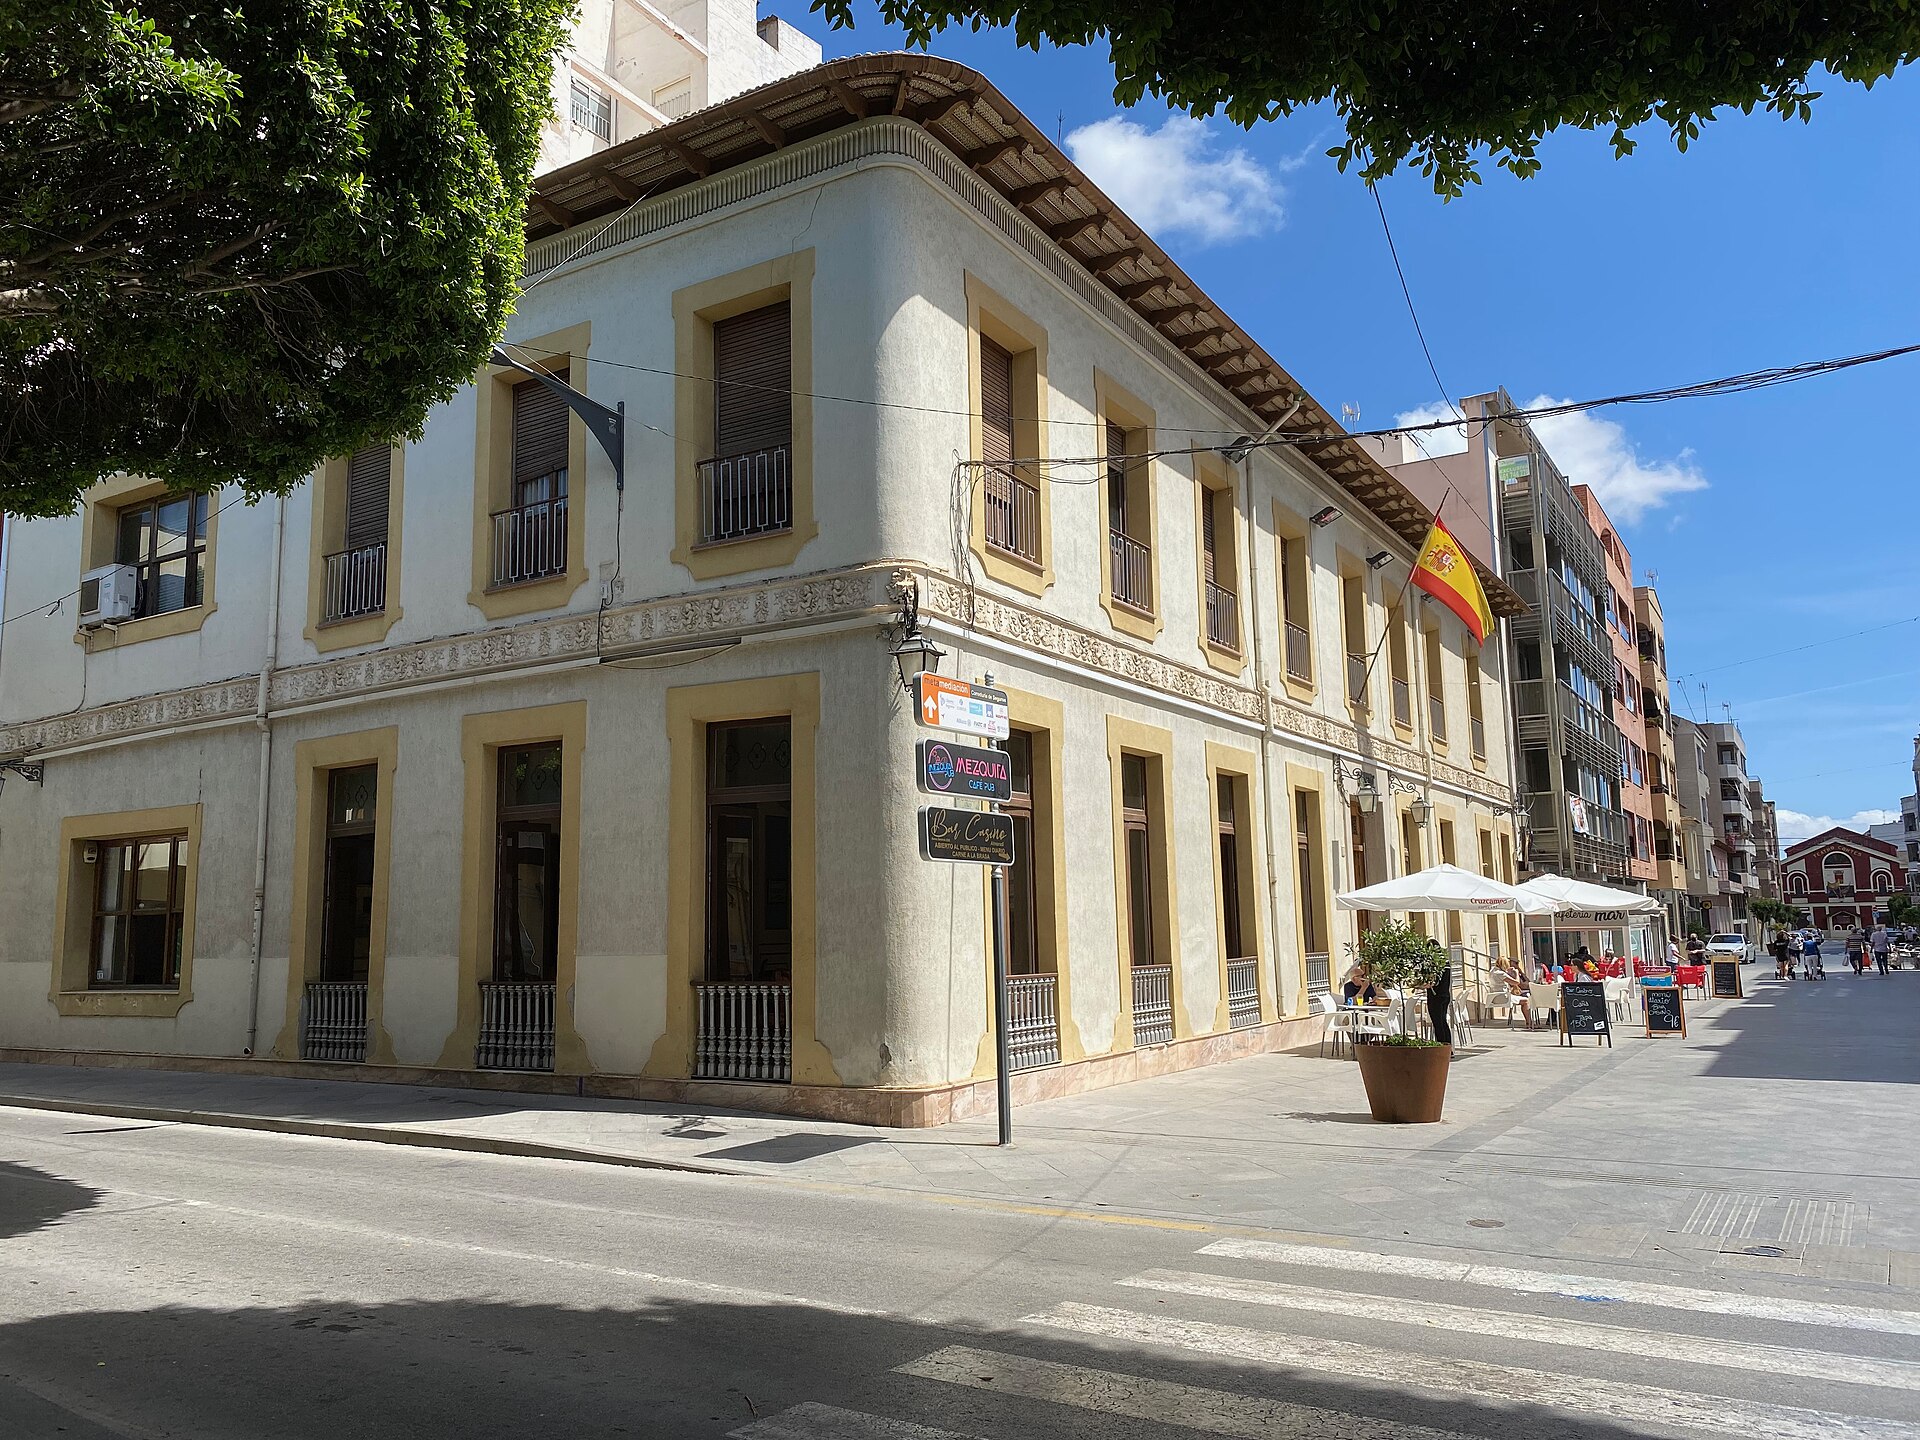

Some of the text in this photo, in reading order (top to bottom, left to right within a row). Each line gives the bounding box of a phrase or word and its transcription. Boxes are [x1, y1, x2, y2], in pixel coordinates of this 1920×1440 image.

[955, 757, 1007, 780] MEZQUITA
[968, 779, 995, 792] CAFÉ PUB
[931, 809, 1007, 841] Bar Casino
[935, 842, 953, 850] ABIERTO
[1594, 909, 1625, 922] mar
